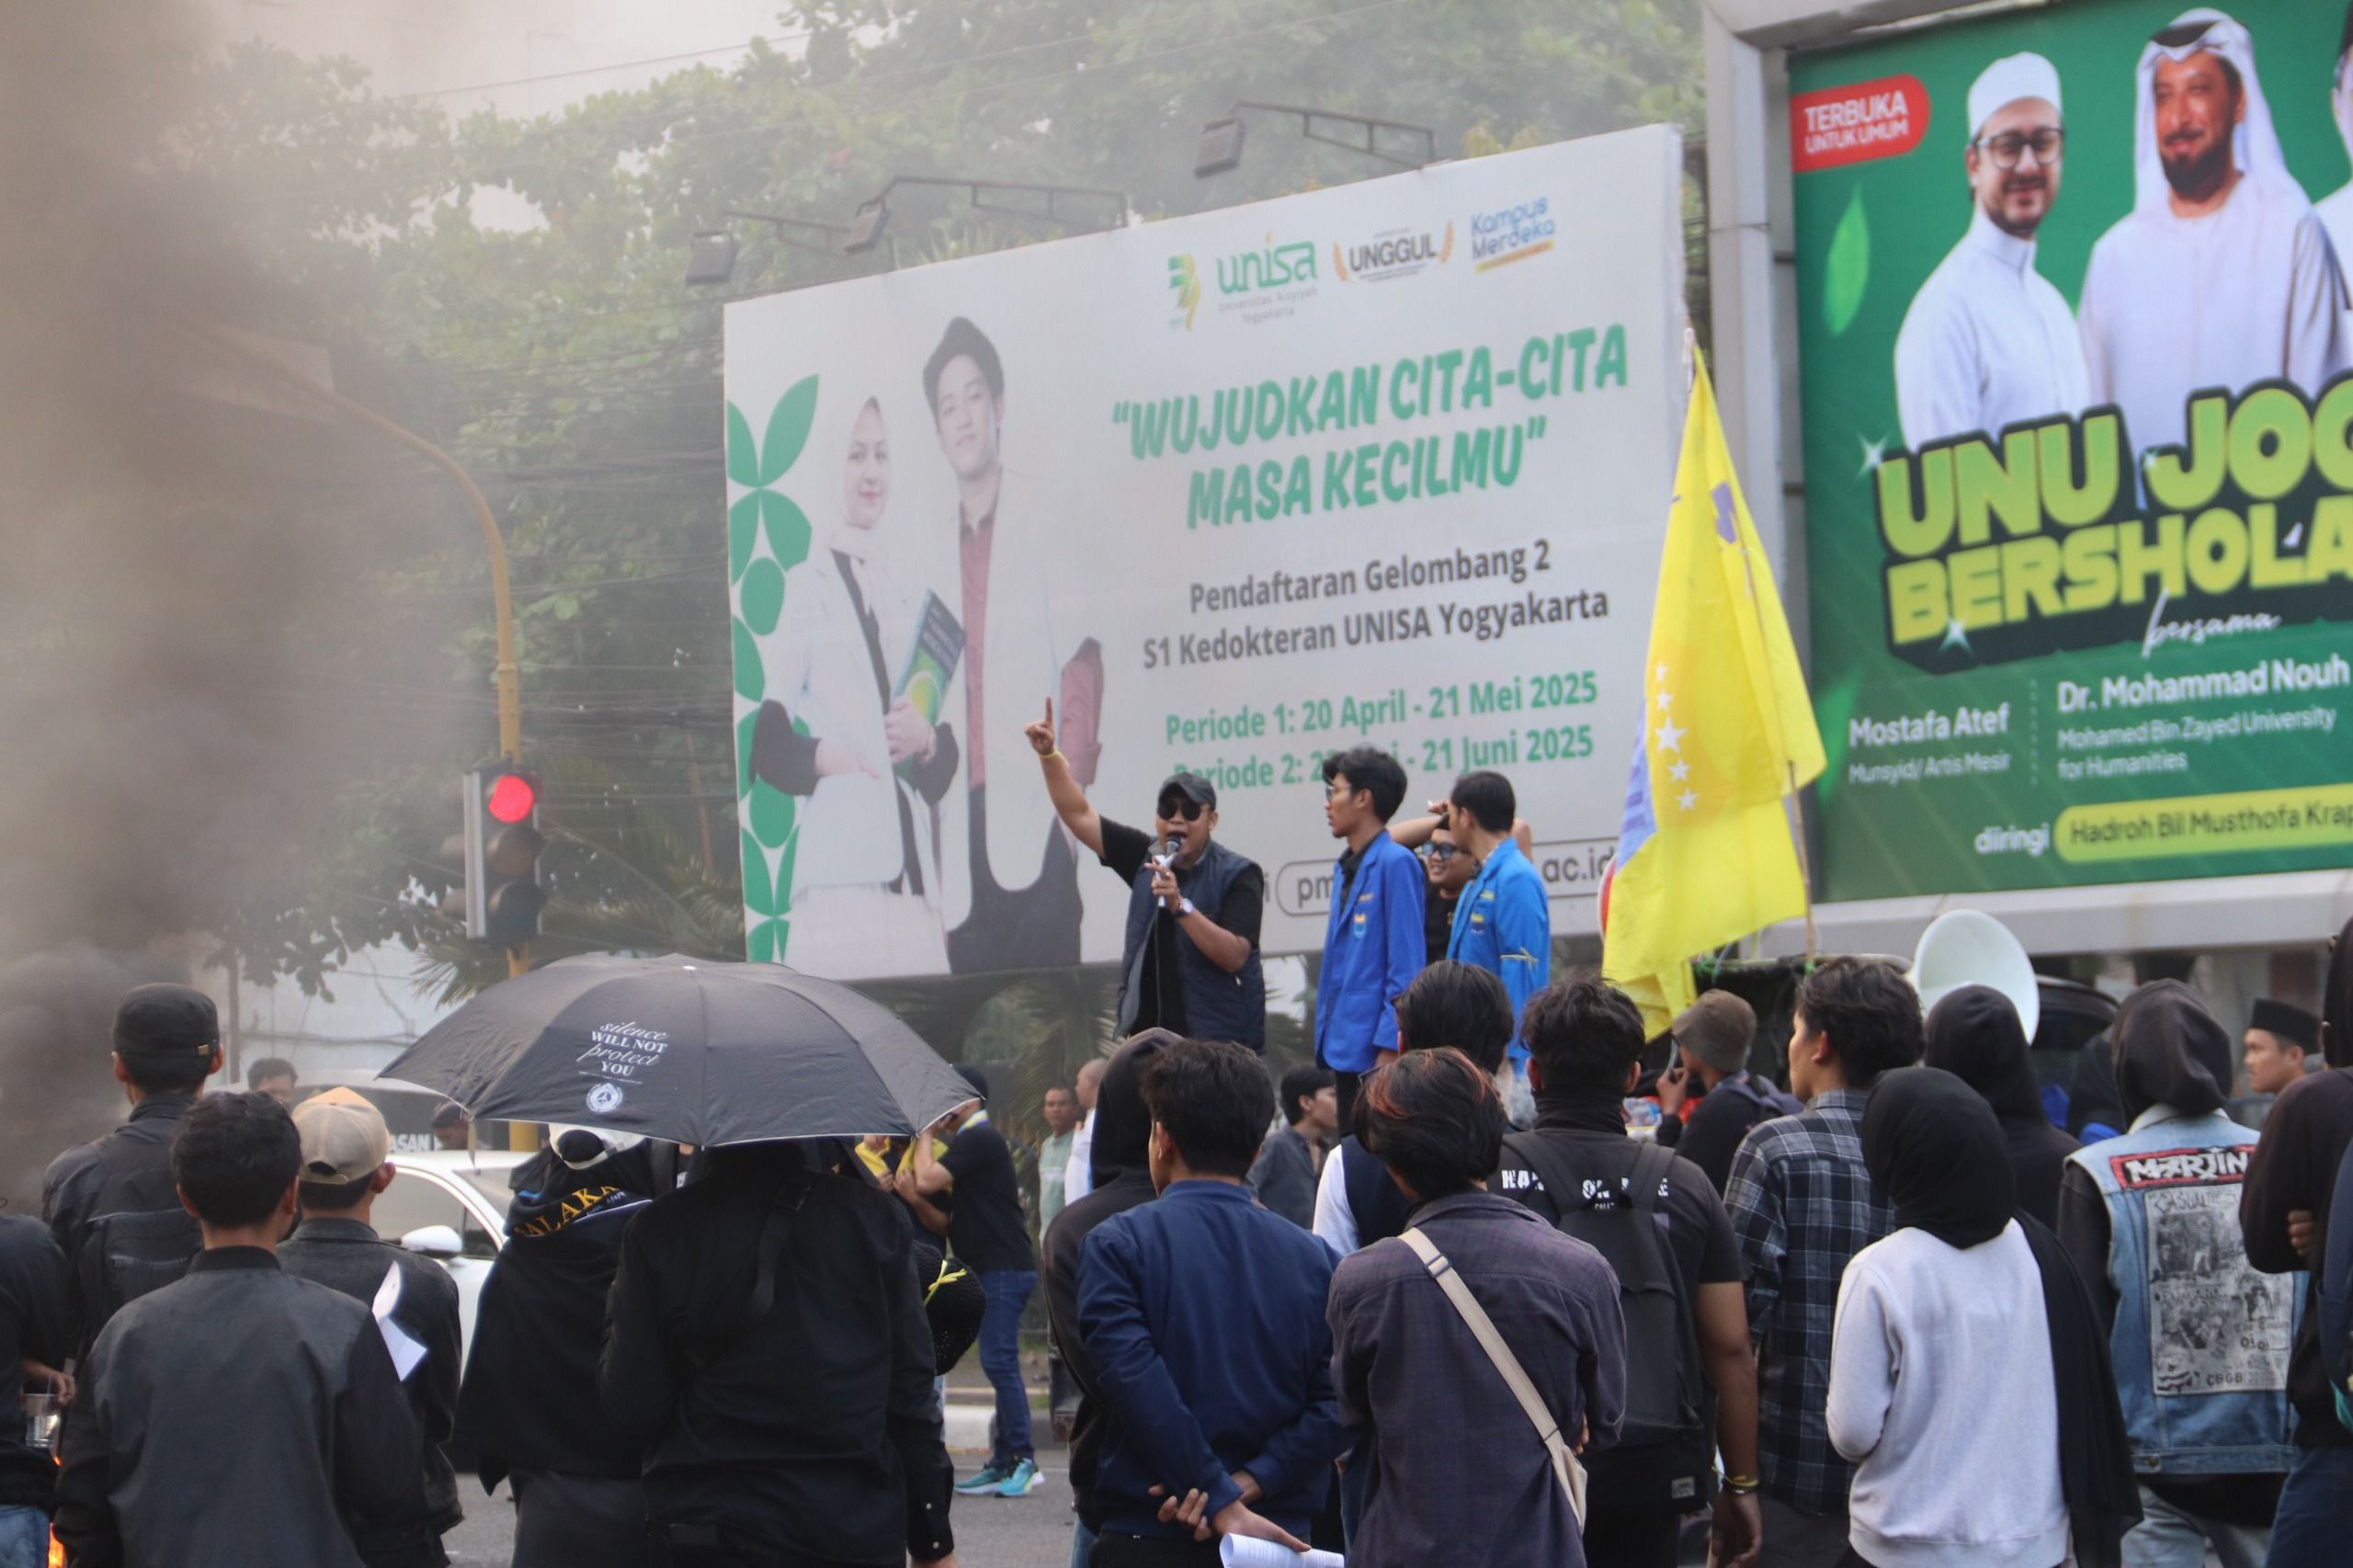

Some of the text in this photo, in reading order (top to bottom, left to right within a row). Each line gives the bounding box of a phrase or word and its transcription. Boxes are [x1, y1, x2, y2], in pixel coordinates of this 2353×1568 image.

[1804, 90, 1909, 133] TERBUKA
[1804, 118, 1910, 154] UNTUK UMUM
[1472, 197, 1549, 235] Kampus
[1472, 219, 1555, 259] Merdeka
[1215, 232, 1318, 294] unisa
[1348, 233, 1438, 272] UNGGUL
[1389, 324, 1627, 420] CITA-CITA
[1187, 455, 1312, 529] MASA
[1878, 413, 2120, 557] UNU
[1189, 539, 1552, 613] Pendaftaran Gelombang 2
[1886, 495, 2353, 644] BERSHOLA
[1142, 590, 1608, 669] S1 Kedokteran UNISA Yogyakarta
[2142, 588, 2282, 659] bersama
[2057, 653, 2351, 712] Dr. Mohammad Nouh
[1165, 705, 1266, 744] Periode
[1274, 703, 1295, 733] 1:
[1303, 699, 1333, 733] 20
[1340, 688, 1406, 735] April
[1430, 686, 1460, 719] 21
[1470, 676, 1522, 715] Mei
[1529, 671, 1597, 709] 2025
[1849, 701, 2011, 749] Mostafa Atef
[2058, 705, 2337, 750] Mohamed Bin Zayed University
[1281, 753, 1302, 785] 2:
[1423, 738, 1453, 772] 21
[1459, 731, 1518, 775] Juni
[1526, 725, 1594, 762] 2025
[1925, 754, 1963, 778] Artis
[1965, 749, 2011, 775] Mesir
[2057, 749, 2189, 779] for Humanities
[1974, 823, 2050, 857] diiringi
[2070, 818, 2154, 846] Hadroh
[2157, 812, 2188, 839] Bil
[2189, 805, 2302, 837] Musthofa
[576, 1042, 661, 1065] protect
[591, 1030, 668, 1053] WILL NOT
[600, 1021, 668, 1040] silence
[601, 1061, 635, 1076] YOU
